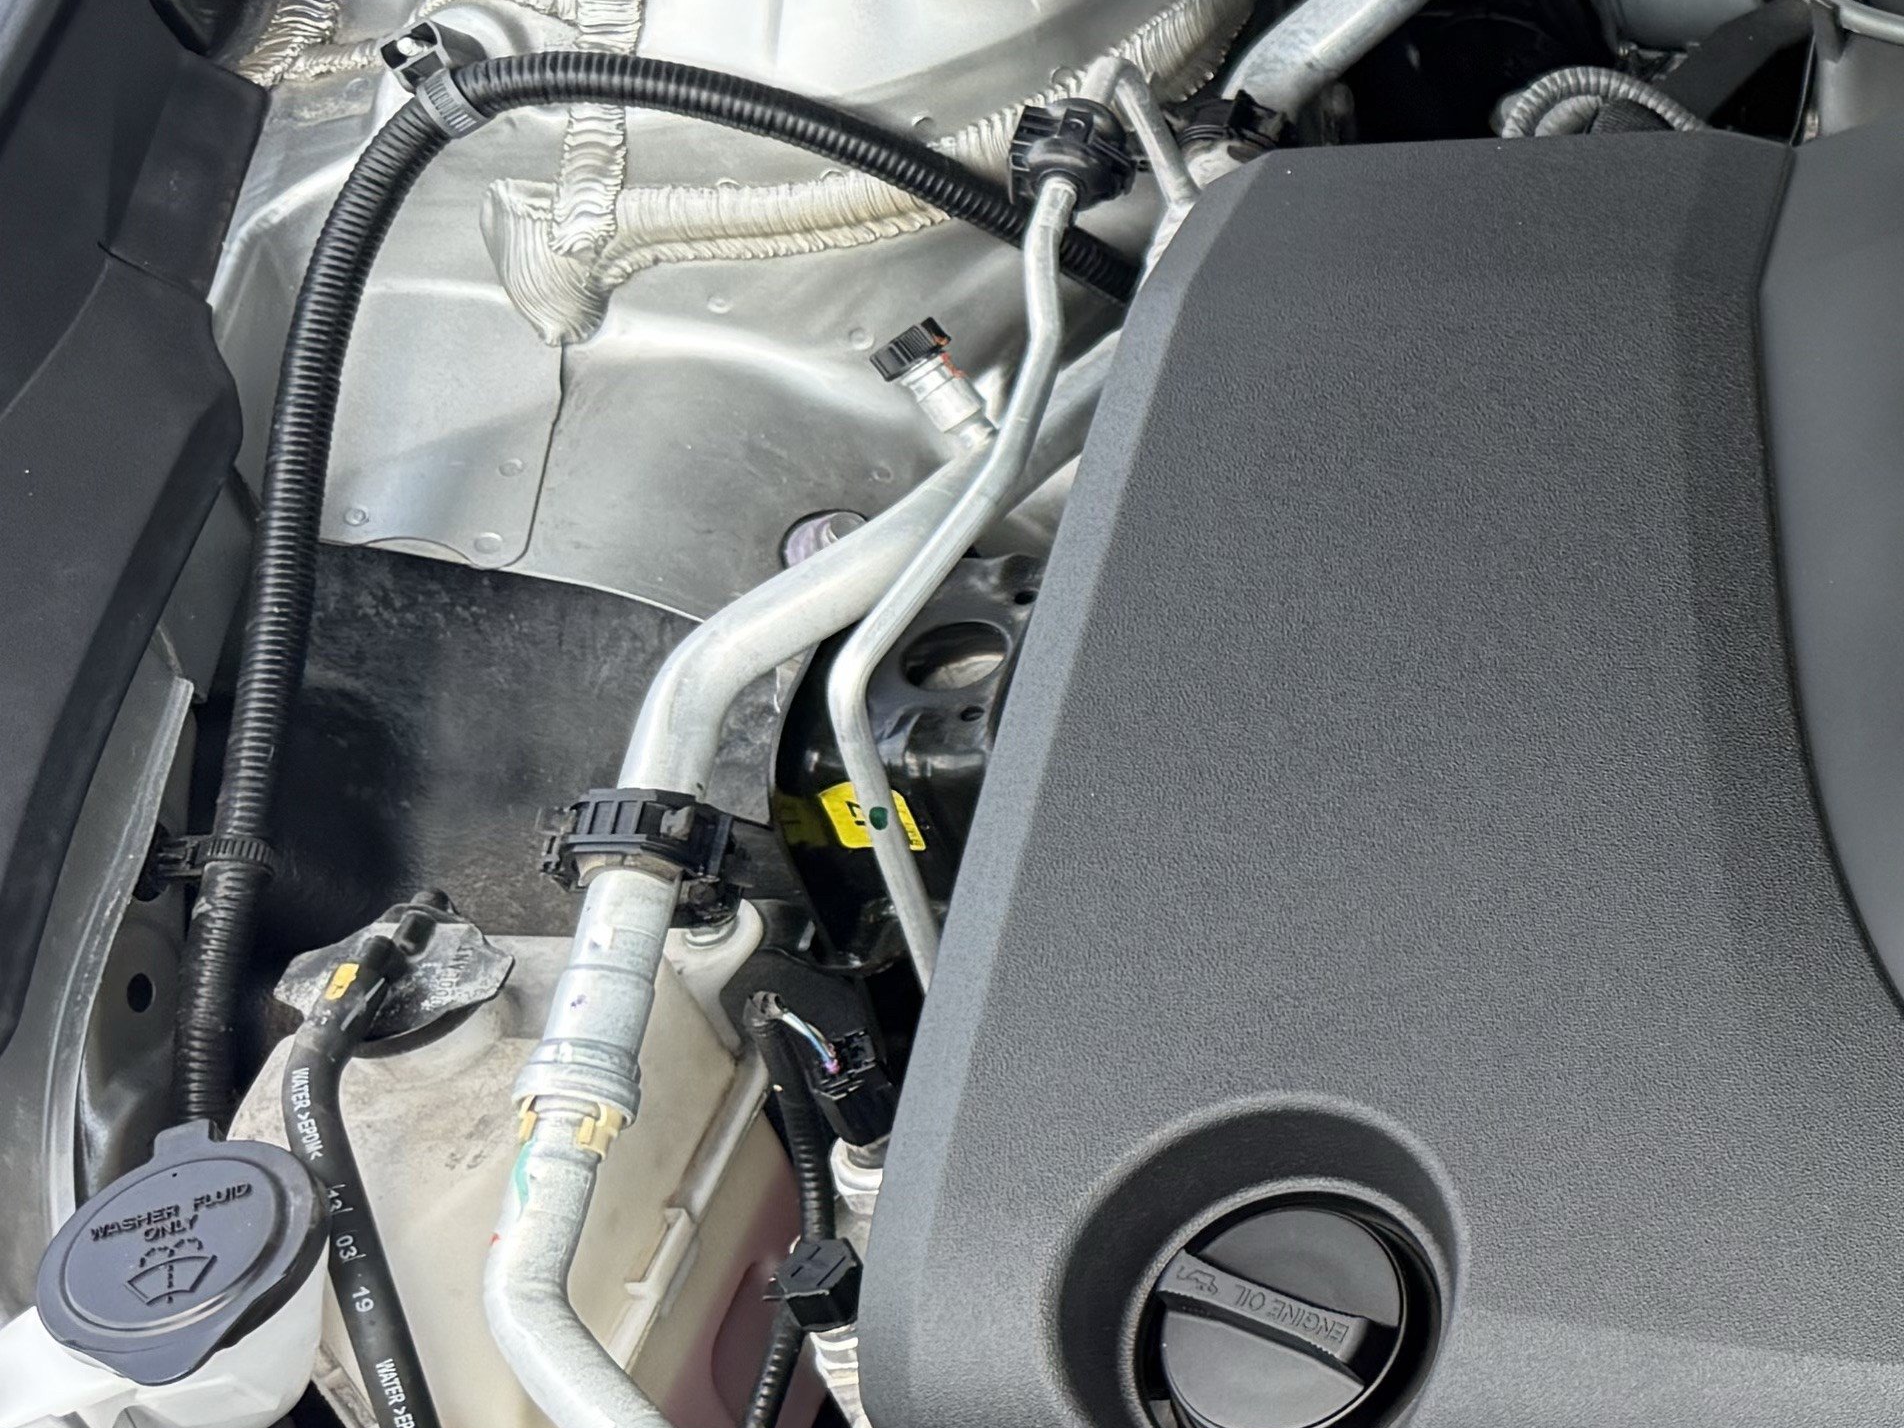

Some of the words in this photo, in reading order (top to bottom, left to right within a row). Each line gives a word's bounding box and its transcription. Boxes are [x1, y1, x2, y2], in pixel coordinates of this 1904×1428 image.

[291, 1067, 311, 1112] WATER
[90, 1204, 180, 1242] WASHER
[192, 1183, 253, 1212] FLUID
[143, 1213, 199, 1243] ONLY
[351, 1285, 375, 1314] 19
[1234, 1283, 1266, 1311] OIL
[1267, 1297, 1350, 1345] ENGINE
[375, 1357, 406, 1407] WATER
